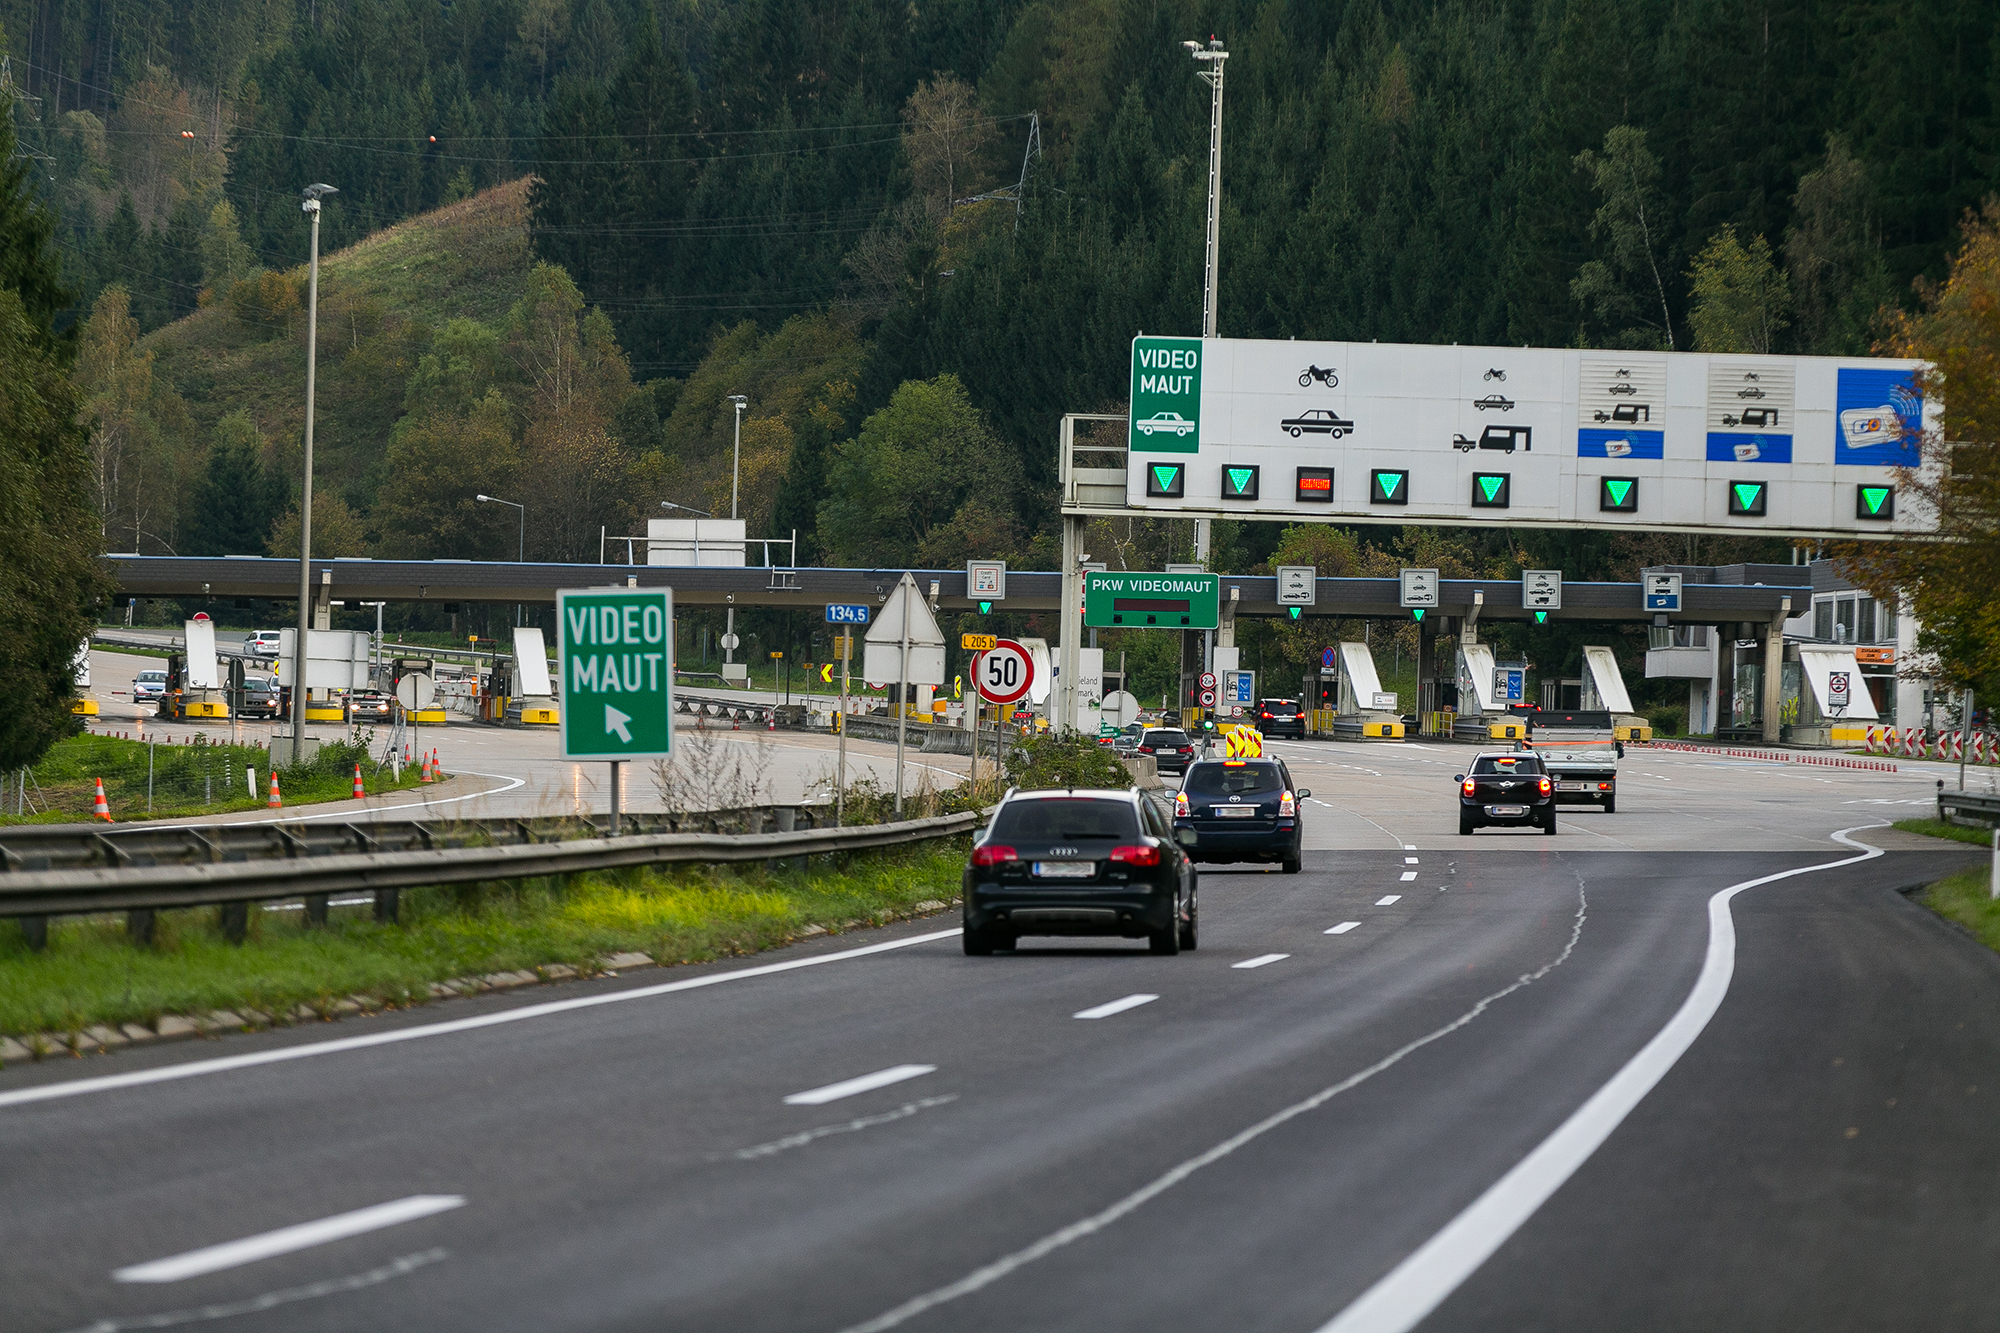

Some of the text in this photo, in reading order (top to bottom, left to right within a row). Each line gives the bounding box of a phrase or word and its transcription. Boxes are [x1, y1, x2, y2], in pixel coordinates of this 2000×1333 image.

[1139, 348, 1197, 370] VIDEO
[1140, 374, 1193, 395] MAUT
[1092, 579, 1212, 593] PKW VIDEOMAUT
[830, 605, 866, 622] 134.5
[567, 605, 662, 646] VIDEO
[963, 636, 995, 648] L 205 b
[573, 653, 663, 694] MAUT
[989, 656, 1017, 687] 50
